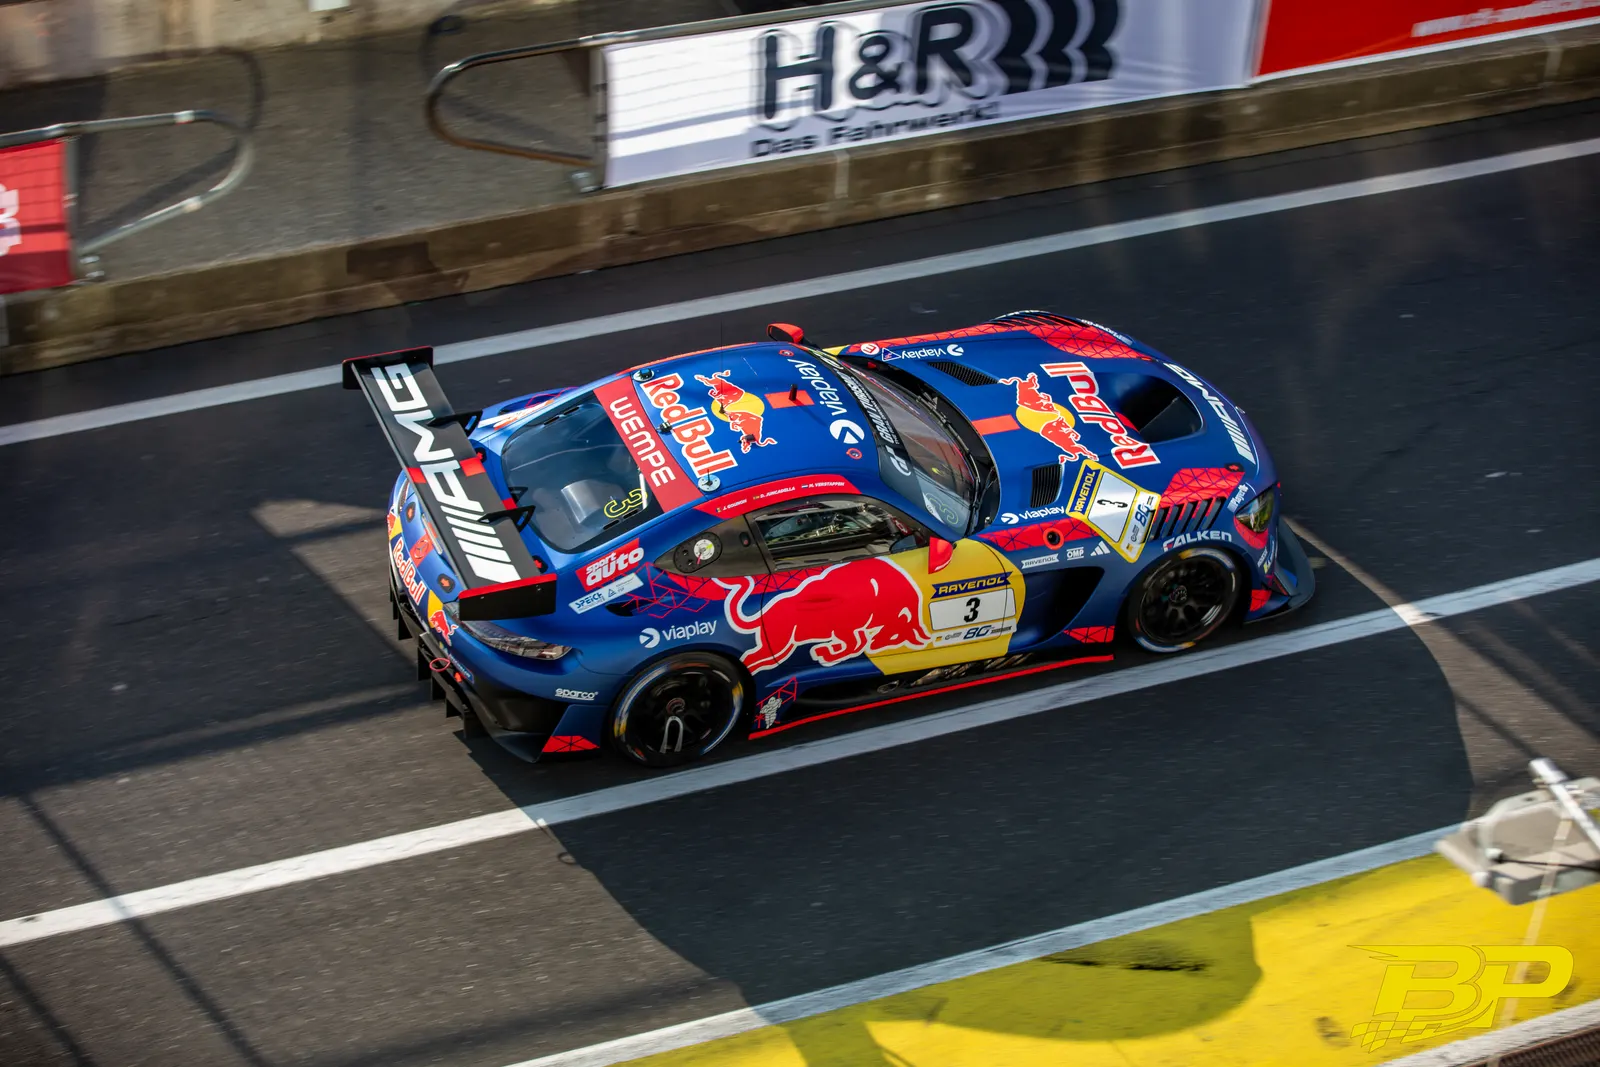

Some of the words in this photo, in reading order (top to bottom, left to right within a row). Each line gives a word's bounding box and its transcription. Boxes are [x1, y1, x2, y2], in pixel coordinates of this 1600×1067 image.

[760, 2, 978, 121] H&R
[751, 133, 818, 158] Das
[901, 346, 946, 360] viaplay
[787, 358, 848, 416] viaplay
[610, 396, 676, 488] WEMPE
[604, 488, 648, 518] 3
[1074, 469, 1096, 514] RAVENOL
[1097, 498, 1129, 508] 3
[1019, 505, 1065, 521] viaplay
[1162, 530, 1232, 553] FALKEN
[586, 552, 617, 575] sport
[1024, 556, 1056, 567] RAVENOL
[1066, 548, 1084, 560] OMP
[586, 547, 645, 587] auto
[938, 577, 1005, 595] RAVENOL
[963, 597, 981, 623] 3
[662, 620, 717, 641] viaplay
[555, 688, 599, 701] sparco
